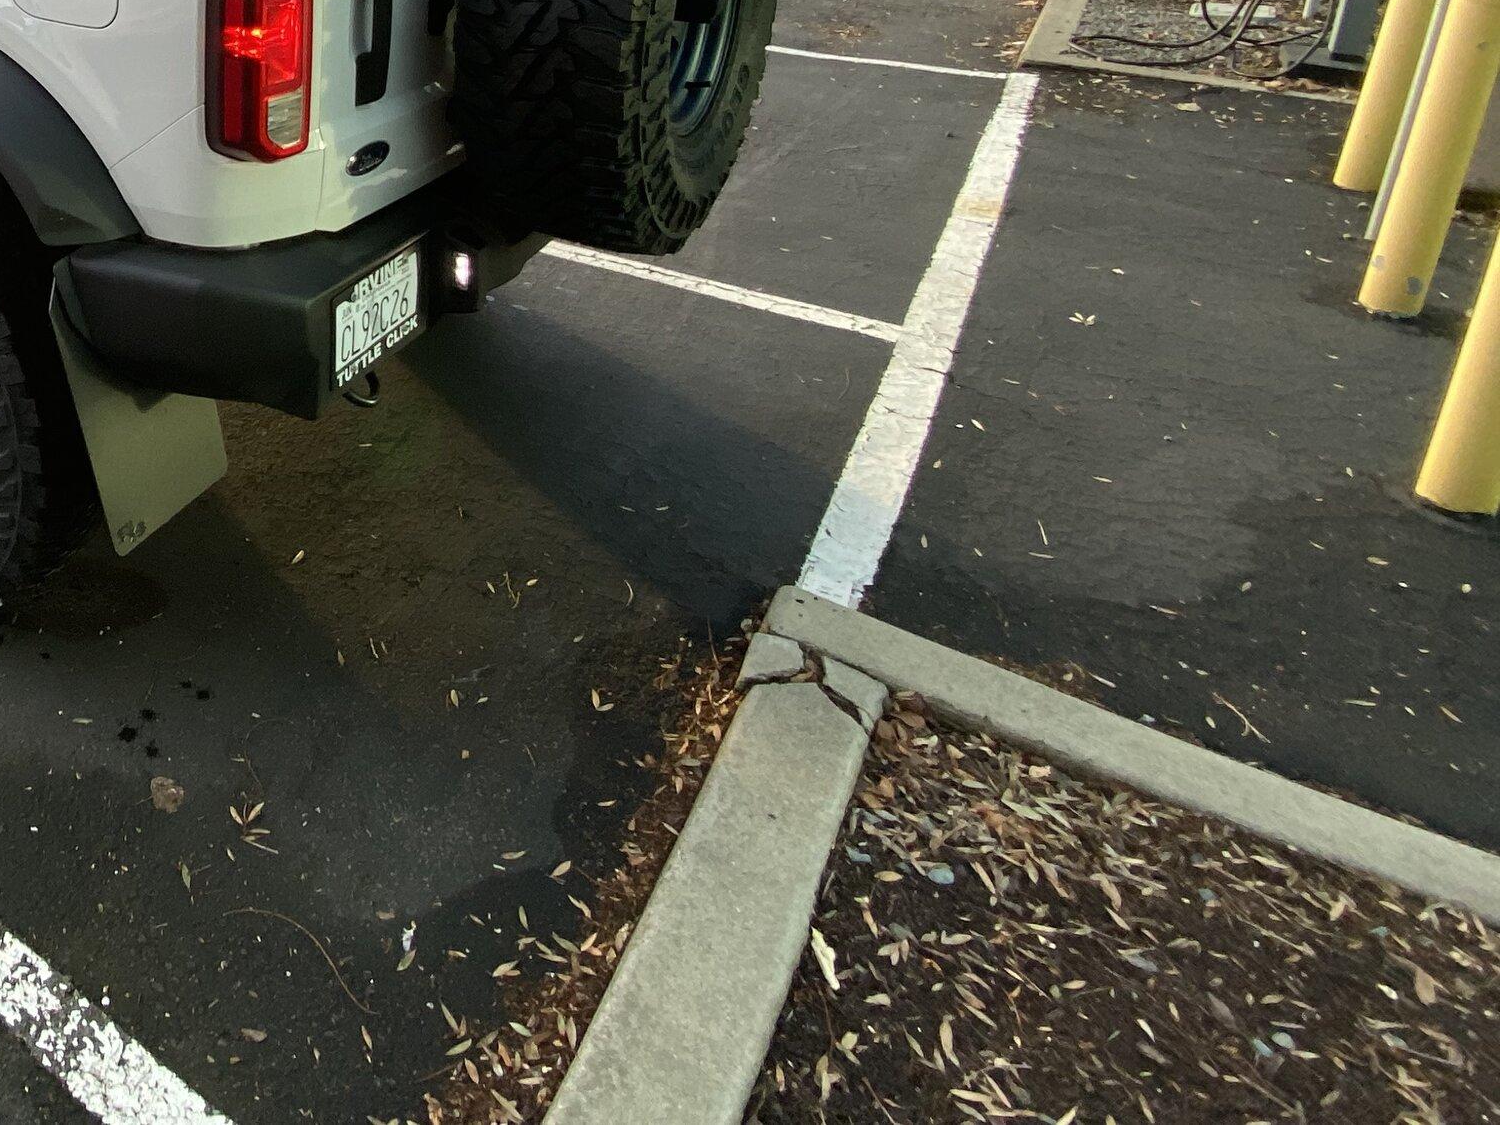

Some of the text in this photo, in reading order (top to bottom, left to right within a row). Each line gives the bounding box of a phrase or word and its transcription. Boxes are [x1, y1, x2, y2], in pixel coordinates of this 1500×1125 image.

[353, 254, 404, 300] IRVINE
[336, 314, 418, 387] TUTTLE CLICK
[341, 281, 409, 362] CL92C26
